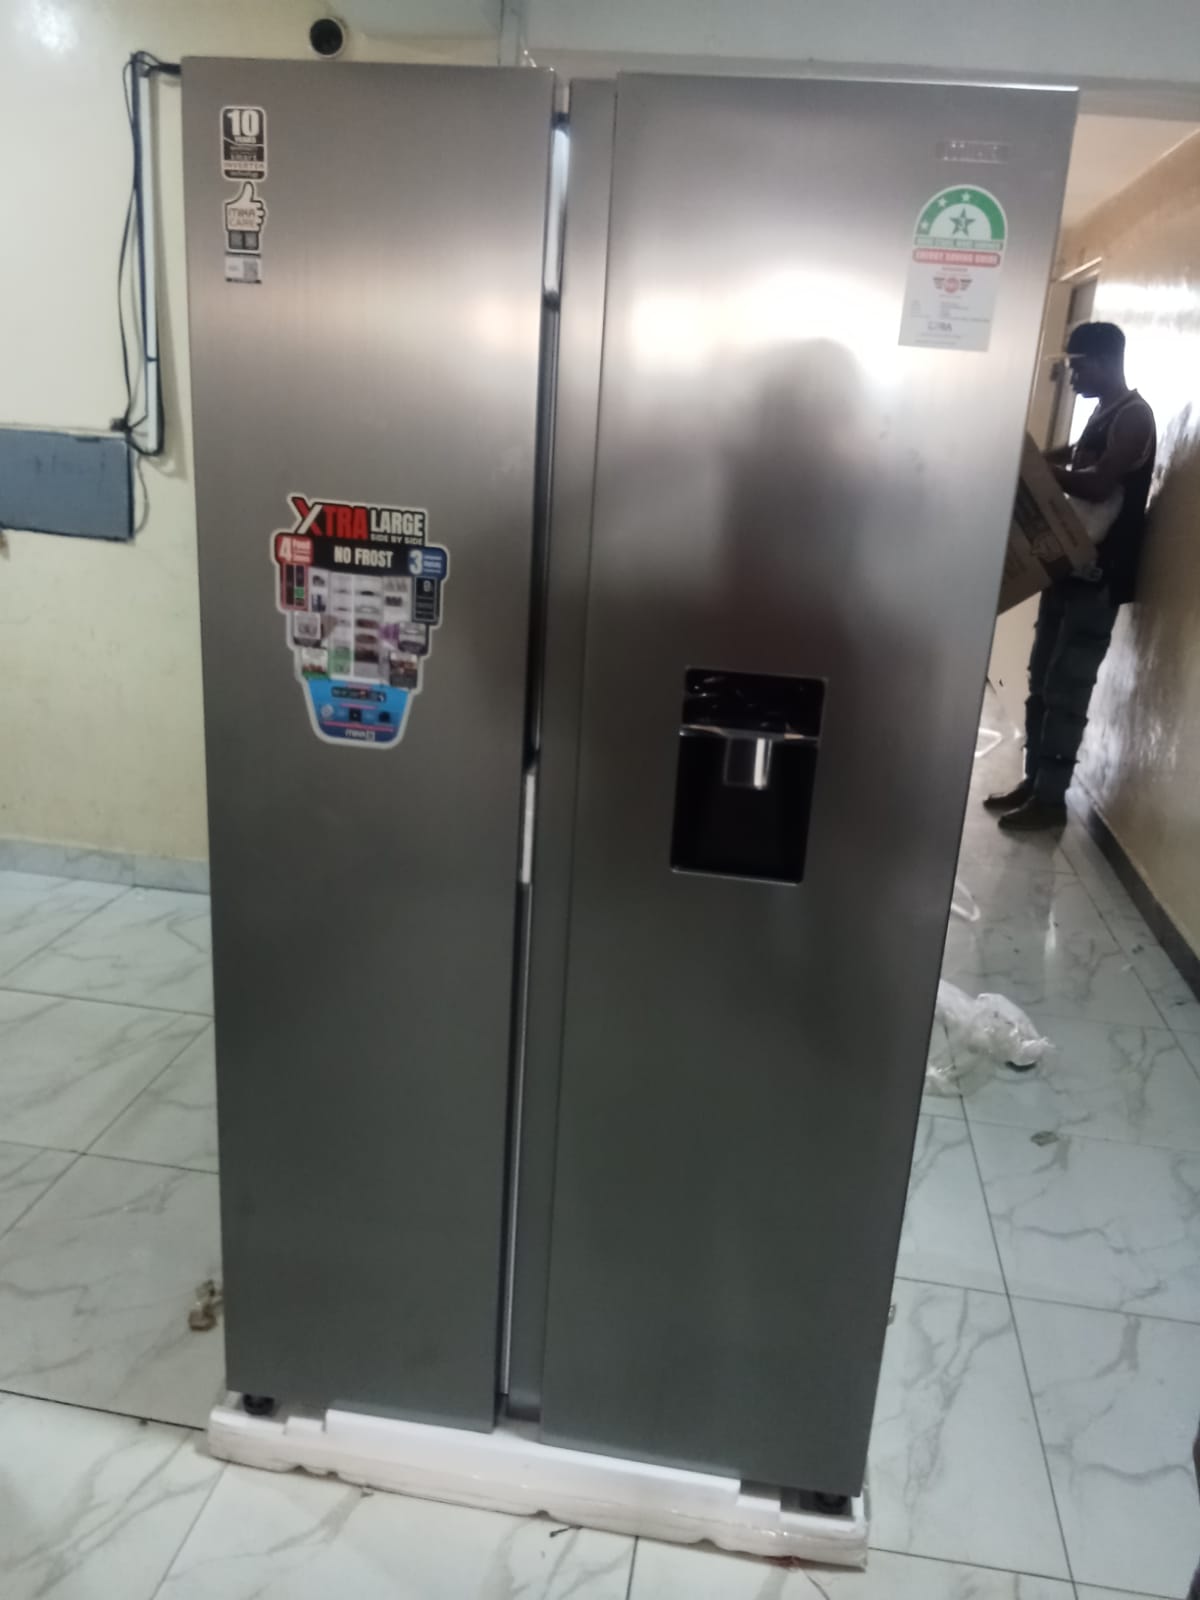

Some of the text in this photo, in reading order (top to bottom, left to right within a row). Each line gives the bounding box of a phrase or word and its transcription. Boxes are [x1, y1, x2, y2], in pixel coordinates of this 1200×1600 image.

[227, 109, 260, 137] 10
[291, 496, 424, 540] XTRA LARGE
[279, 536, 292, 562] 4
[370, 533, 423, 546] SIDE BY SIDE
[333, 546, 351, 564] NO
[354, 550, 394, 569] FROST
[408, 549, 423, 575] 3
